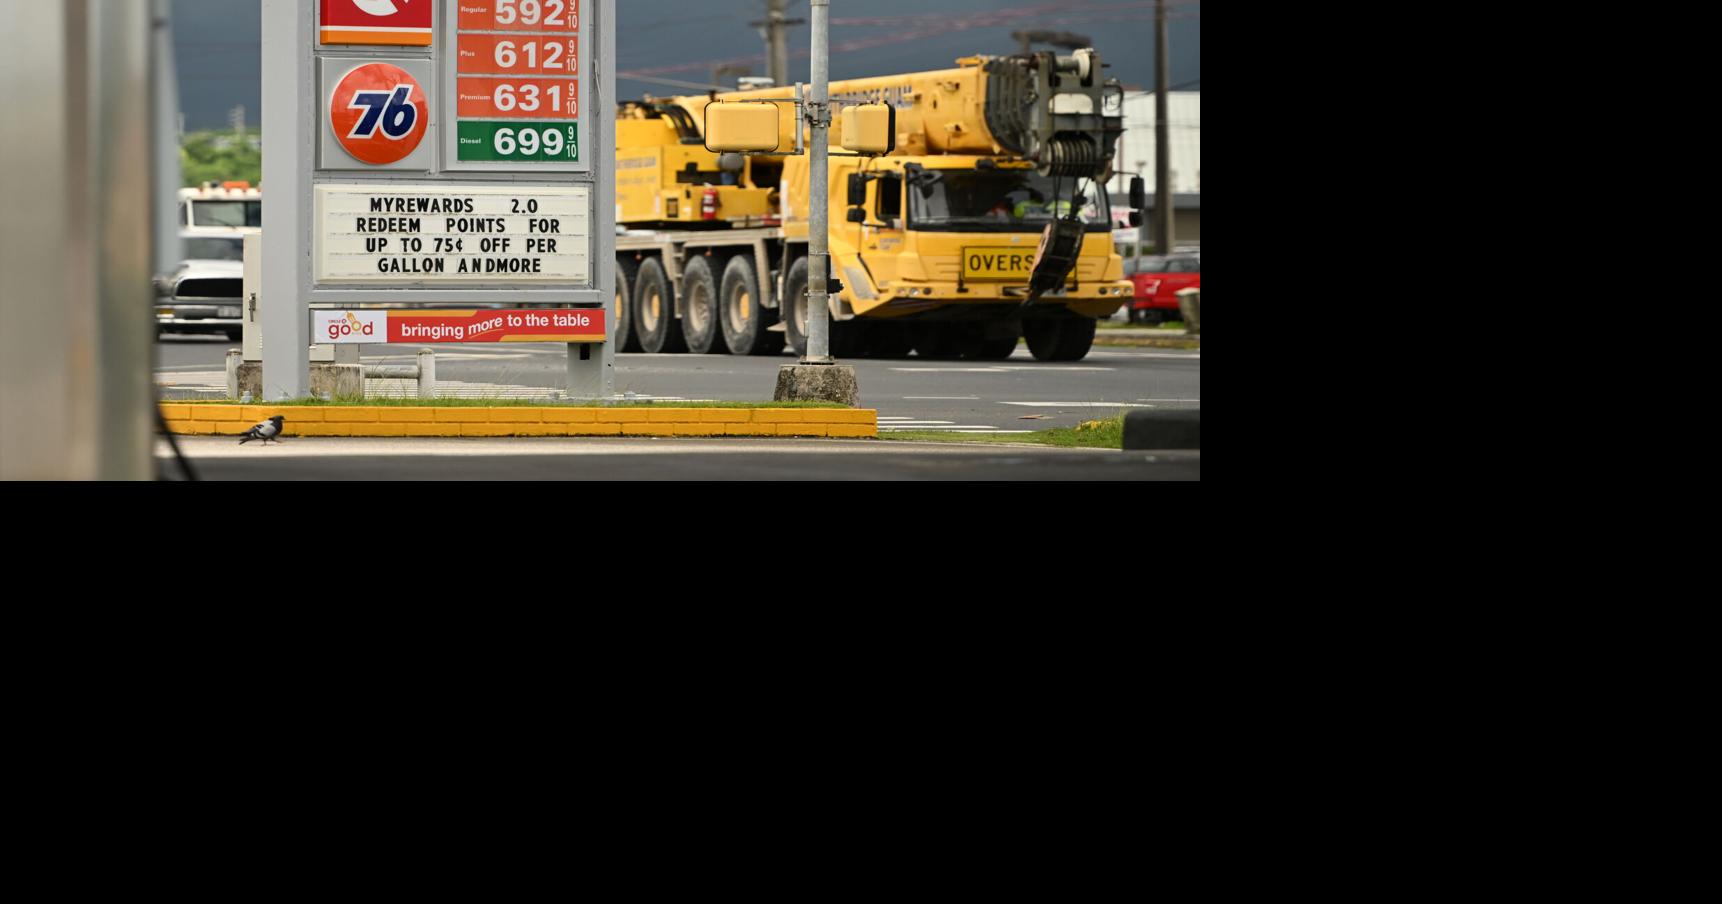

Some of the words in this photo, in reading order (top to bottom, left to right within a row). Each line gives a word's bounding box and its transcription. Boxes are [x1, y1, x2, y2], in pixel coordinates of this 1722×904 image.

[495, 0, 564, 25] 592
[494, 41, 563, 68] 612
[460, 93, 490, 101] Premium
[494, 84, 561, 111] 631
[347, 84, 417, 140] 76
[460, 137, 481, 145] Diesel
[494, 128, 564, 155] 699
[370, 198, 474, 213] MYREWARDS
[511, 198, 538, 213] 2.0
[357, 217, 421, 233] REDEEM
[446, 217, 506, 233] POINTS
[529, 218, 560, 233] FOR
[366, 237, 388, 252] UP
[402, 237, 422, 252] TO
[434, 237, 463, 253] 75¢
[480, 237, 511, 252] OFF
[526, 238, 557, 253] PER
[378, 257, 445, 273] GALLON
[328, 320, 373, 340] good
[401, 323, 464, 340] bringing
[468, 316, 503, 335] more
[507, 315, 523, 327] to
[525, 314, 550, 327] the
[553, 314, 590, 327] table
